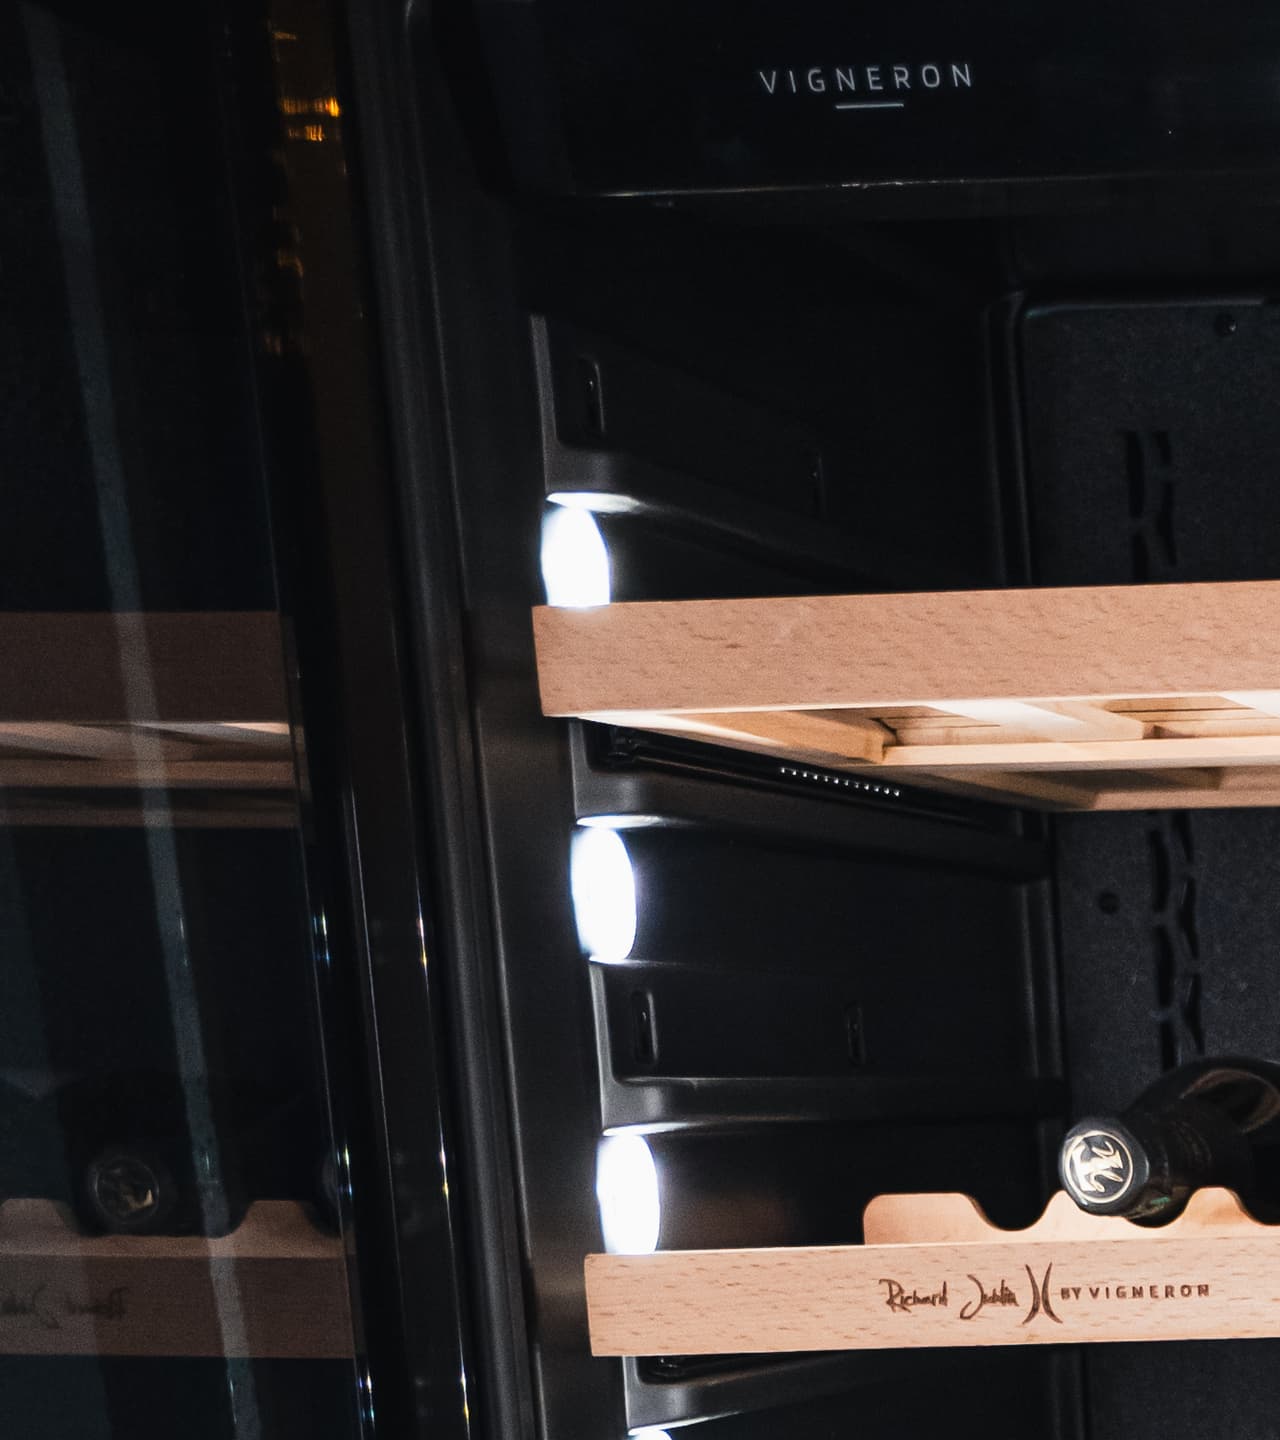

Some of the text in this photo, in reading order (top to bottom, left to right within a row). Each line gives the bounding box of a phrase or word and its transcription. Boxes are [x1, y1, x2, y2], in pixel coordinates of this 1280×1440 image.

[758, 63, 973, 95] VIGNERON
[1060, 1286, 1082, 1300] BY
[1089, 1283, 1211, 1300] VIGNERON
